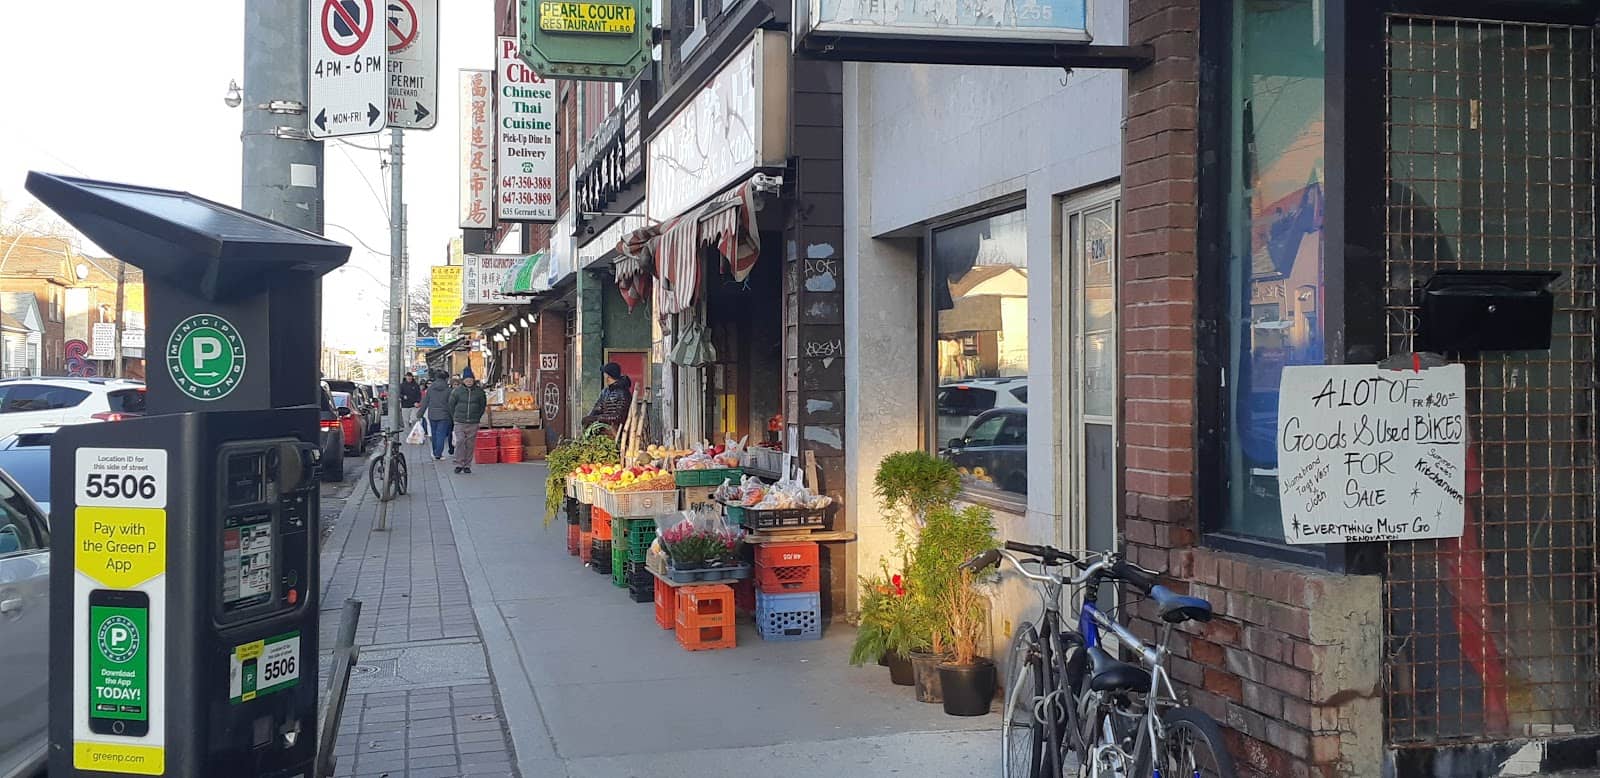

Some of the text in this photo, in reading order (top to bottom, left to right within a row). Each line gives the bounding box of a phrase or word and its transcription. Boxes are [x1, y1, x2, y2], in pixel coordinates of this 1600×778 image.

[543, 3, 631, 20] PEARL COURT
[542, 18, 607, 32] RESTAURANT
[315, 59, 323, 79] 4
[326, 61, 341, 77] PM
[354, 54, 362, 74] 6
[366, 56, 381, 73] PM
[391, 75, 424, 89] PERMIT
[502, 85, 552, 98] Chinese
[512, 101, 542, 114] Thai
[332, 112, 362, 124] MON-FRI
[502, 117, 552, 129] Cuisine
[503, 133, 552, 146] Pick-Up Dine In
[507, 147, 546, 160] Delivery
[502, 175, 552, 190] 647-350-3888
[502, 191, 552, 205] 647-350-3889
[502, 208, 513, 216] 635
[514, 208, 537, 216] Gerrard
[171, 319, 240, 354] MUNICIPAL
[192, 337, 222, 369] P
[542, 356, 557, 368] 637
[172, 365, 241, 396] PARKING
[1312, 376, 1424, 408] A LOT OF
[1283, 416, 1347, 452] Goods
[1377, 418, 1409, 443] Used
[1344, 451, 1397, 476] FOR
[86, 473, 156, 499] 5506
[94, 522, 145, 538] Pay with
[83, 540, 156, 554] the Green P
[106, 558, 132, 573] App
[111, 627, 127, 646] P
[101, 668, 136, 678] Download
[264, 656, 295, 681] 5506
[105, 677, 132, 687] the App
[95, 686, 141, 701] TODAY!
[92, 751, 145, 764] greenp.com
